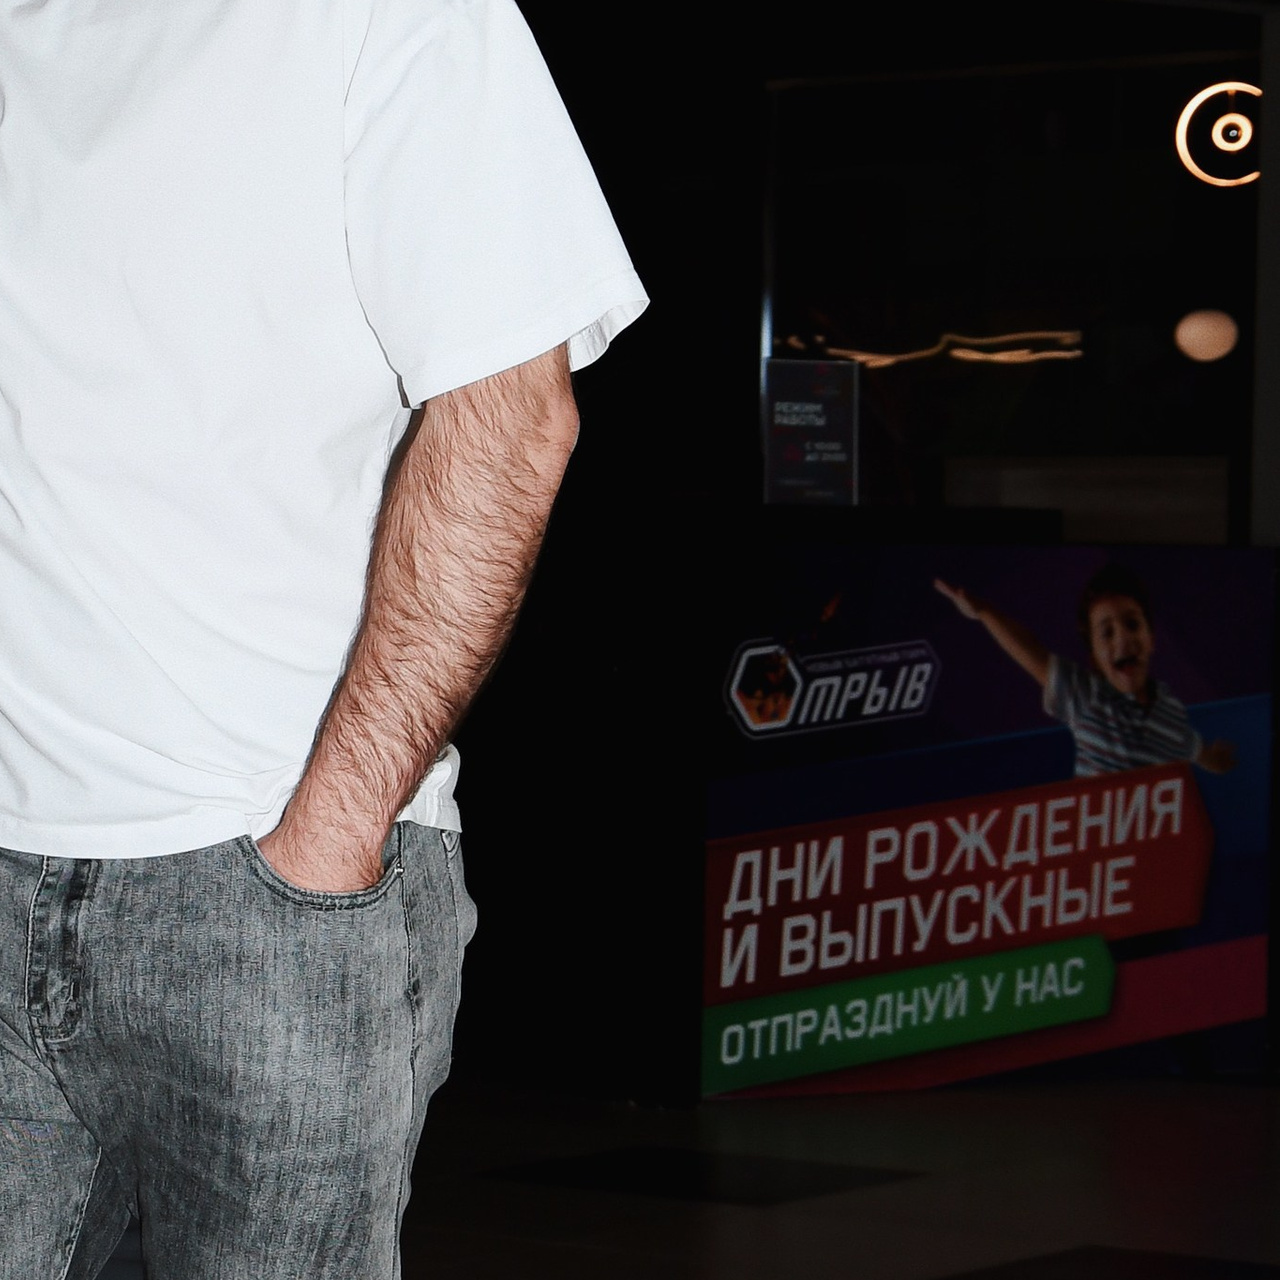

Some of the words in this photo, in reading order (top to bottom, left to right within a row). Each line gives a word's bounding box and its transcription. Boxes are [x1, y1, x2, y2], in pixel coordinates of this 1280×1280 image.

[723, 835, 845, 920] ДНИ
[864, 777, 1185, 889] РОЖДЕНИЯ
[720, 923, 759, 988] И
[778, 856, 1137, 977] ВЫПУСКНЫЕ
[721, 973, 968, 1065] ОТПРАЗДНУЙ
[981, 973, 1005, 1012] У
[1015, 957, 1086, 1008] НАС
